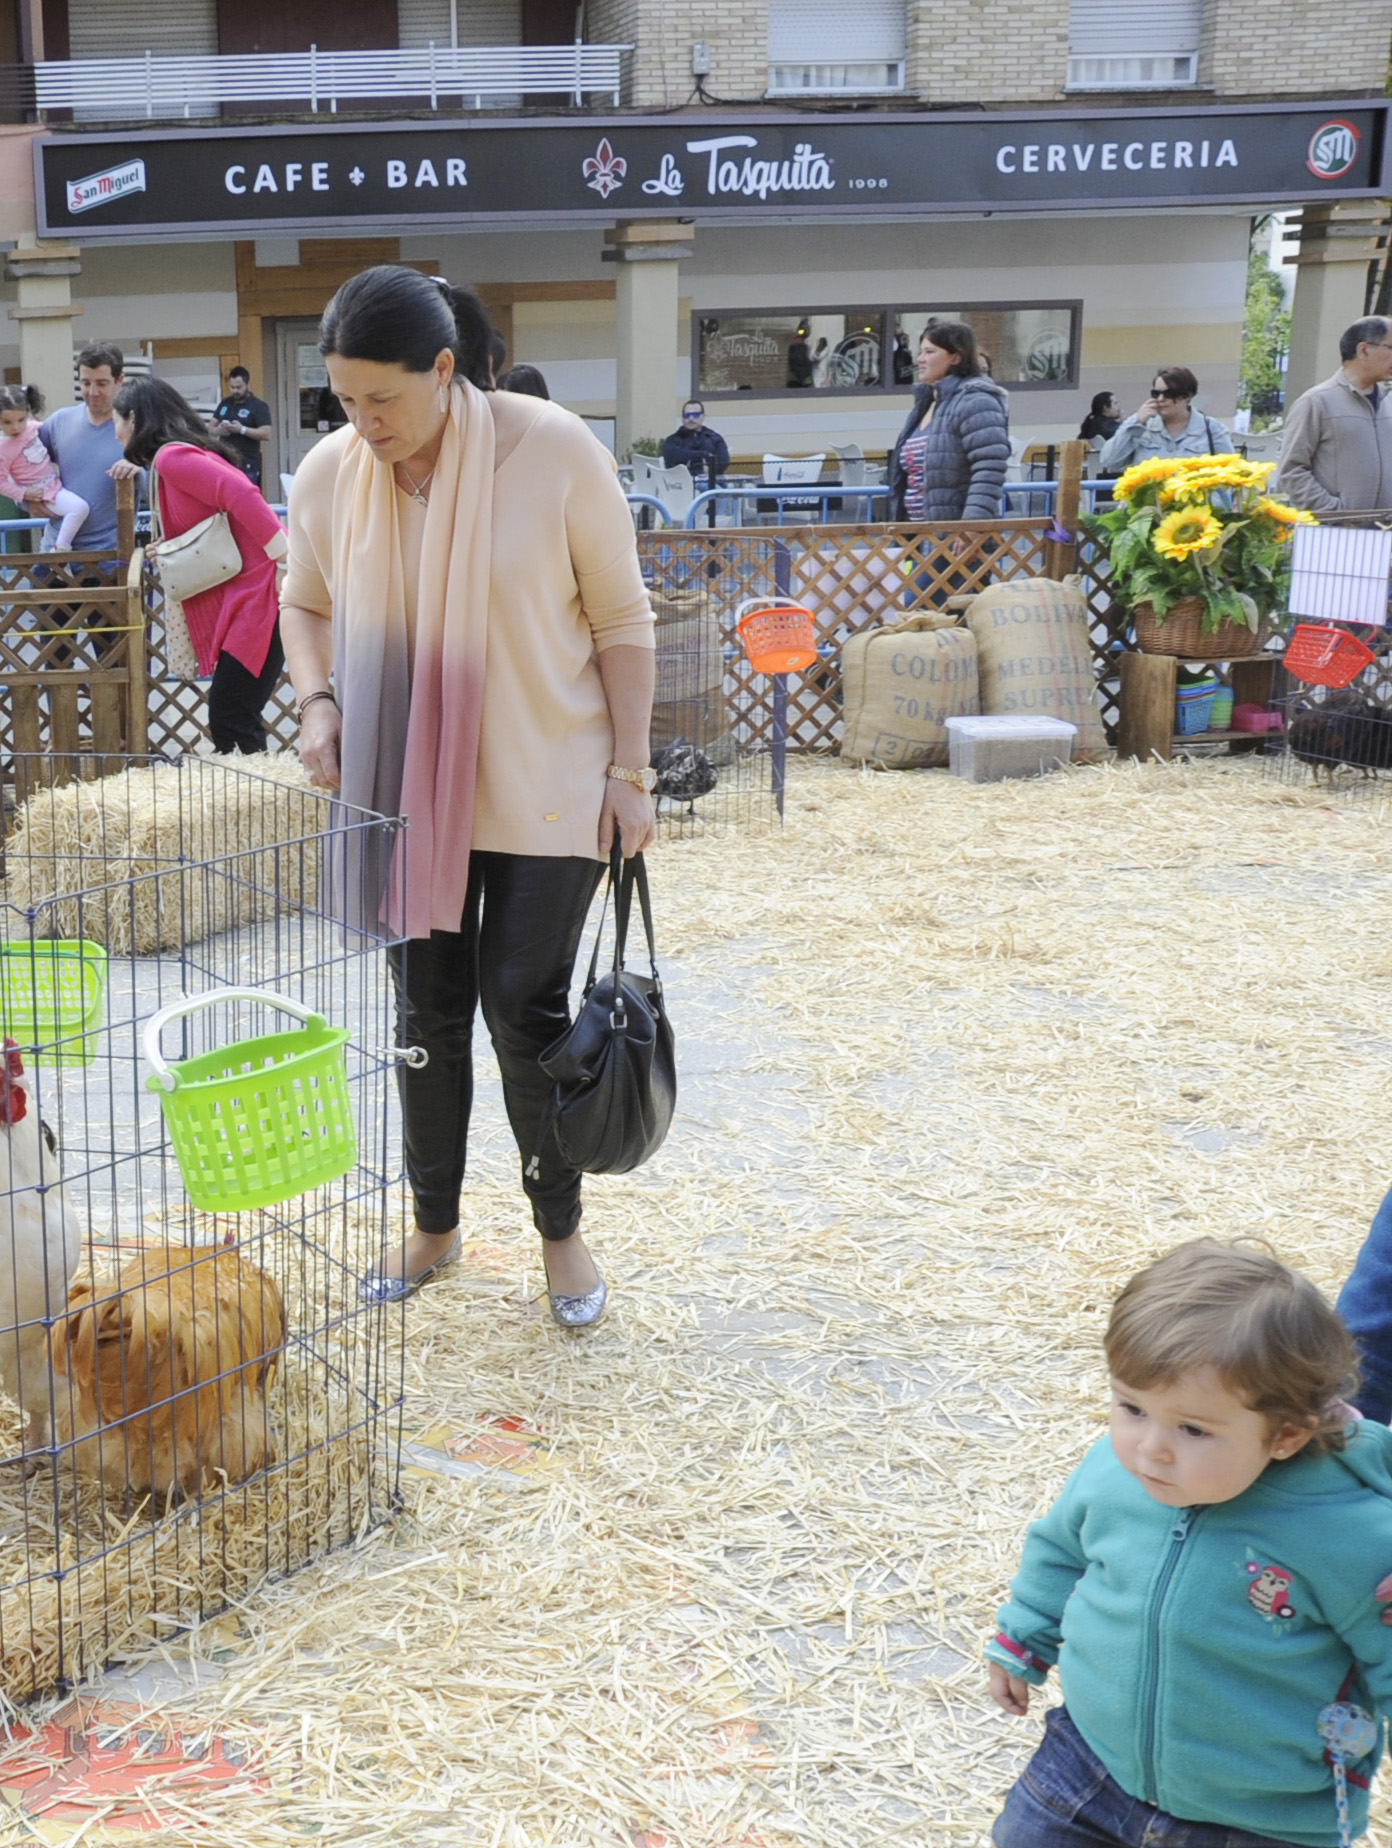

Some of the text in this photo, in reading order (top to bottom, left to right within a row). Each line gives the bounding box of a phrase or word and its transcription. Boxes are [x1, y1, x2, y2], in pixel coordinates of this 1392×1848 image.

[641, 135, 889, 200] La Tasquita 1998
[996, 139, 1239, 173] CERVECERIA
[71, 167, 139, 208] San Miguel
[225, 158, 468, 194] CAFE BAR
